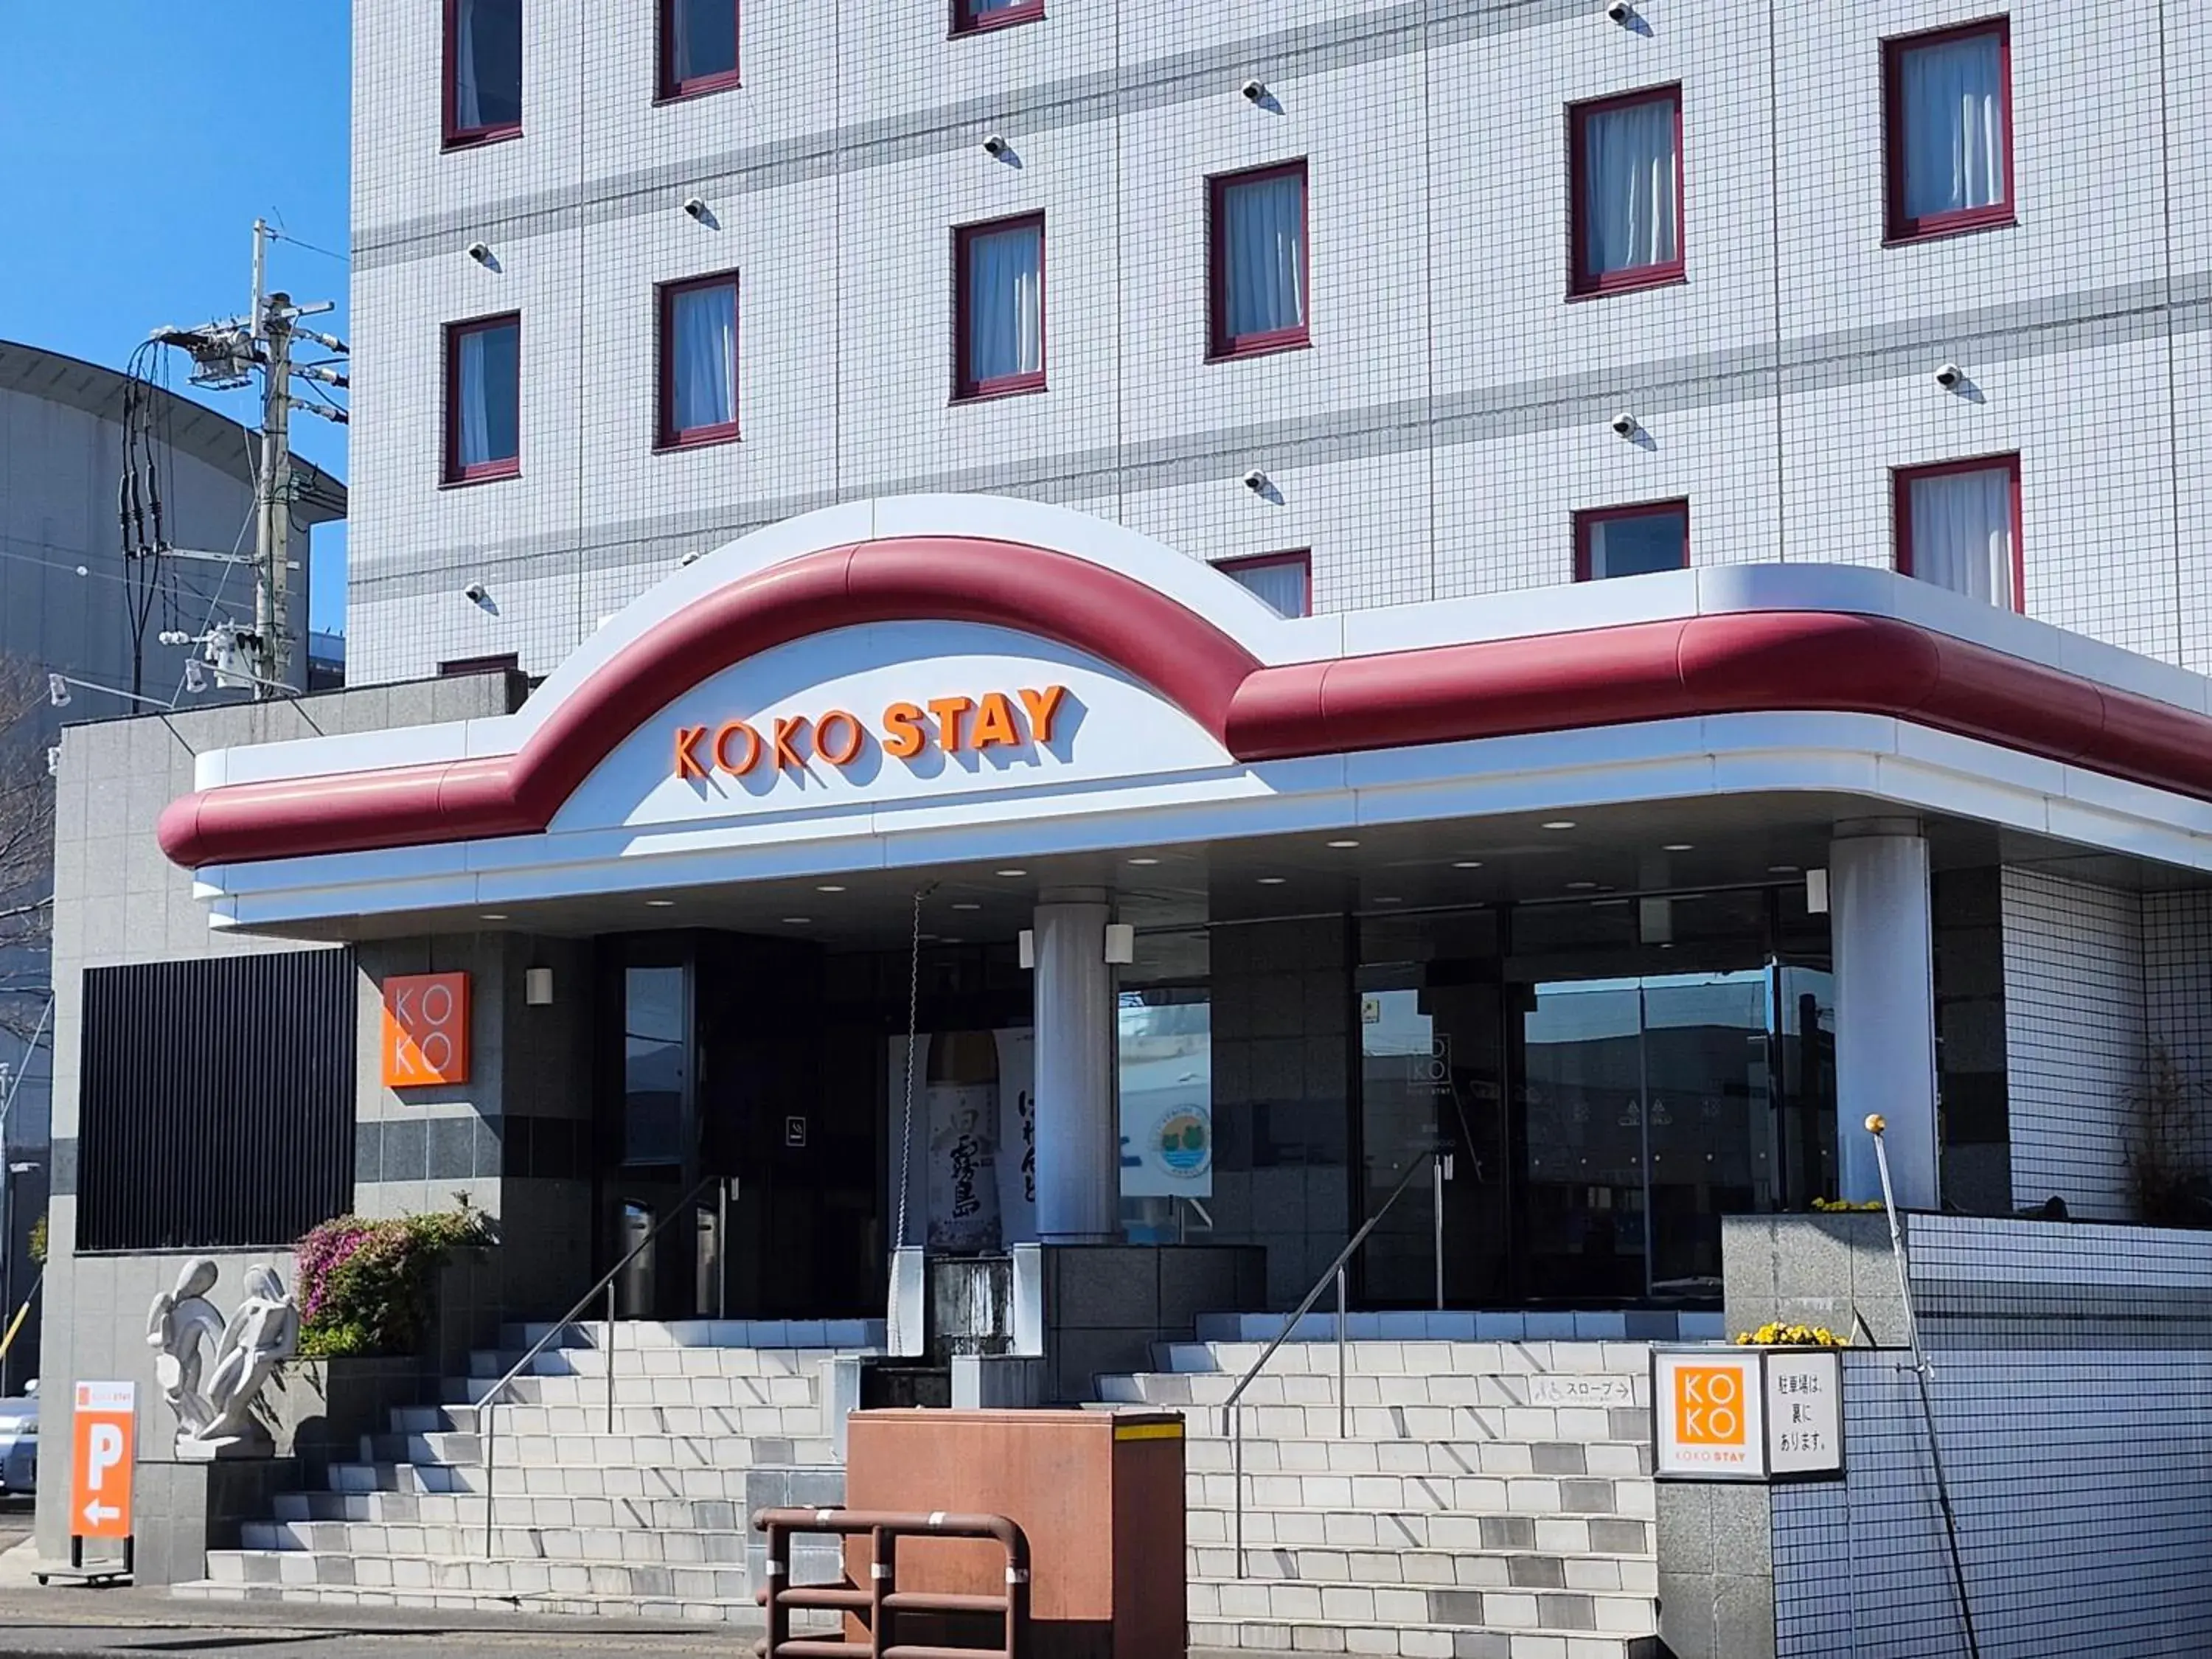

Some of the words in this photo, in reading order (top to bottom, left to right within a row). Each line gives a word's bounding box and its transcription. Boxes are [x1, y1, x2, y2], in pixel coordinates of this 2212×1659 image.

[675, 710, 864, 779] KOKO
[883, 685, 1066, 757] STAY
[396, 984, 452, 1026] KO
[395, 1030, 451, 1075] KO
[1685, 1373, 1736, 1405] KO
[1686, 1408, 1736, 1439] KO
[88, 1423, 124, 1490] P
[1714, 1451, 1745, 1463] STAY
